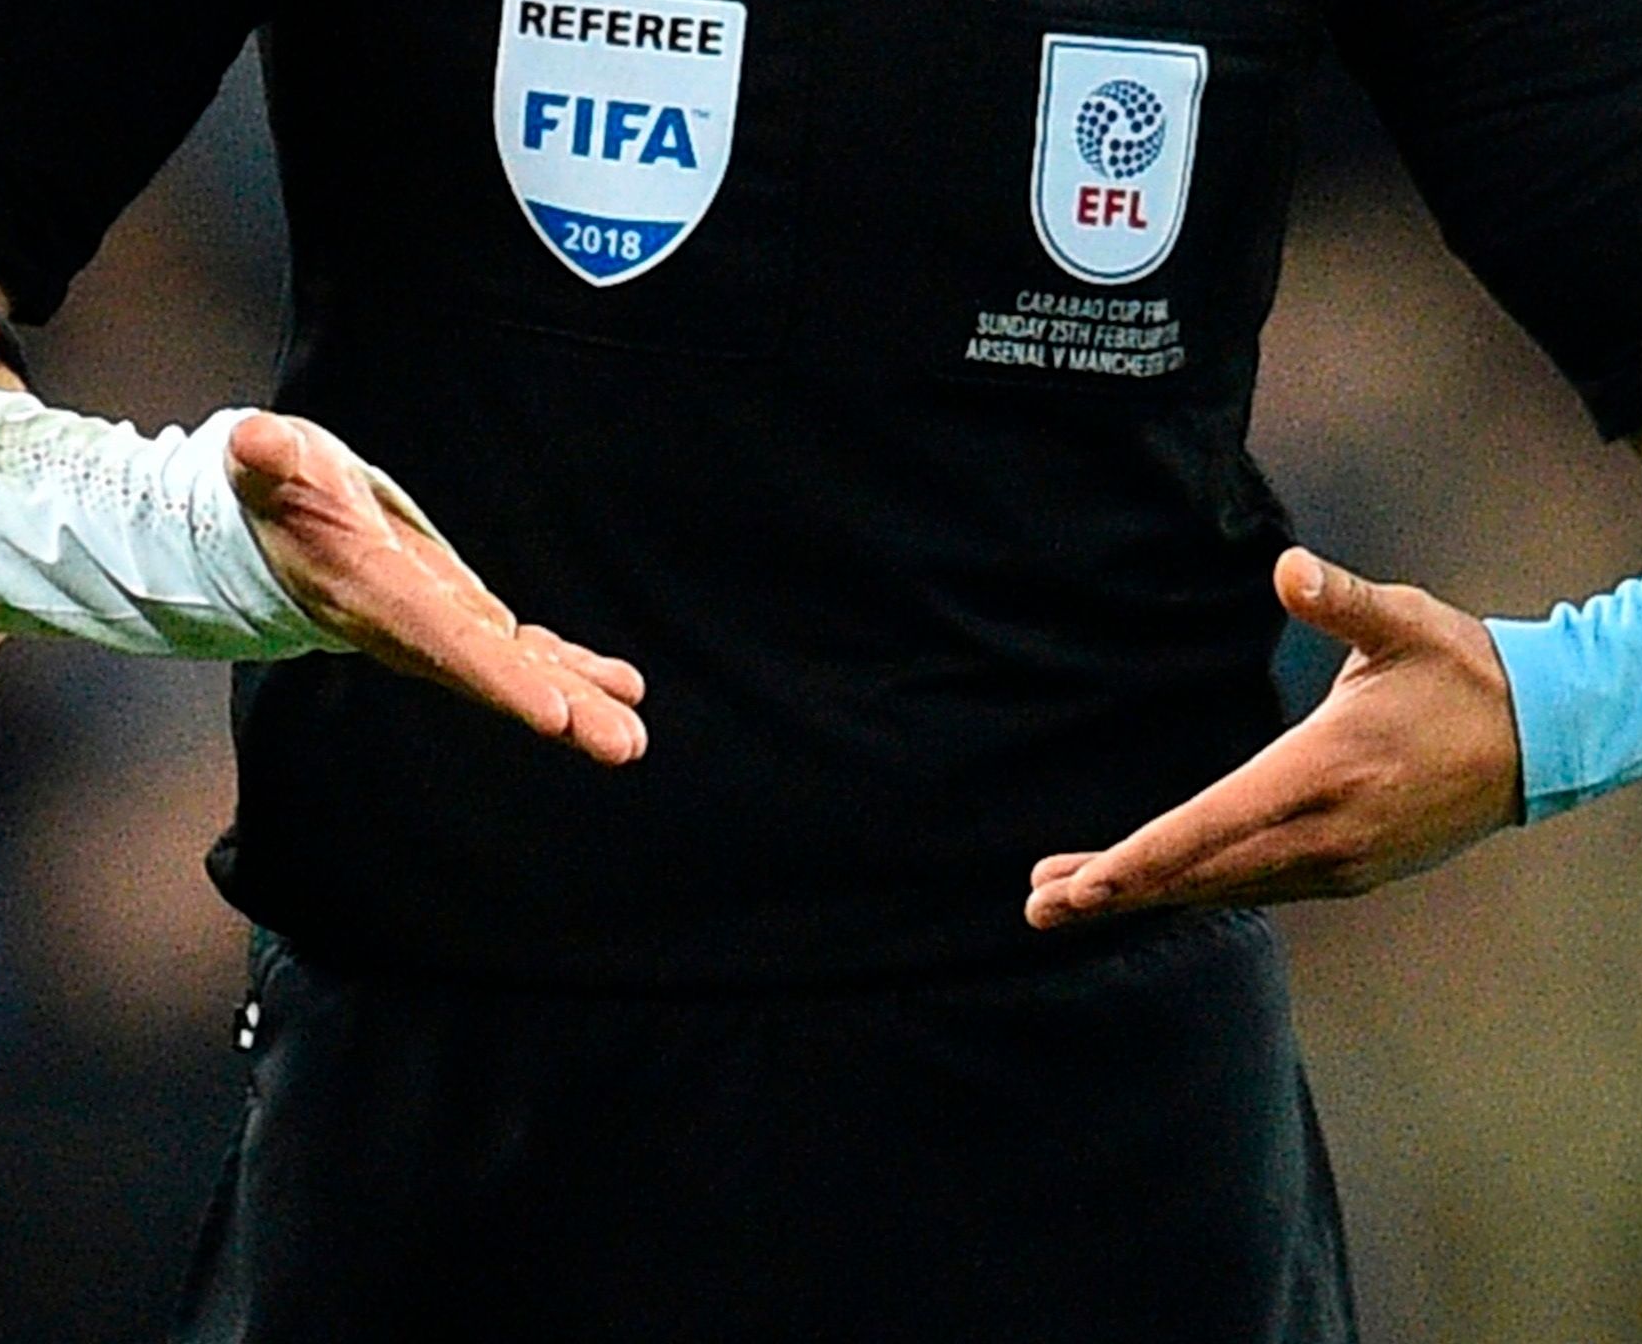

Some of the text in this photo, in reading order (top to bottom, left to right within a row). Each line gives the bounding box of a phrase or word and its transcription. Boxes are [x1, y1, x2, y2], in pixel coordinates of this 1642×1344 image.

[518, 0, 725, 56] REFEREE
[523, 90, 698, 169] FIFA
[1076, 186, 1148, 230] EFL
[563, 222, 642, 261] 2018
[1016, 290, 1104, 320] CARABAO
[1107, 299, 1142, 322] CUP
[975, 311, 1048, 340] SUNDAY
[1048, 319, 1092, 344] 25TH
[965, 337, 1047, 368] ARSENAL
[1052, 346, 1066, 369] V
